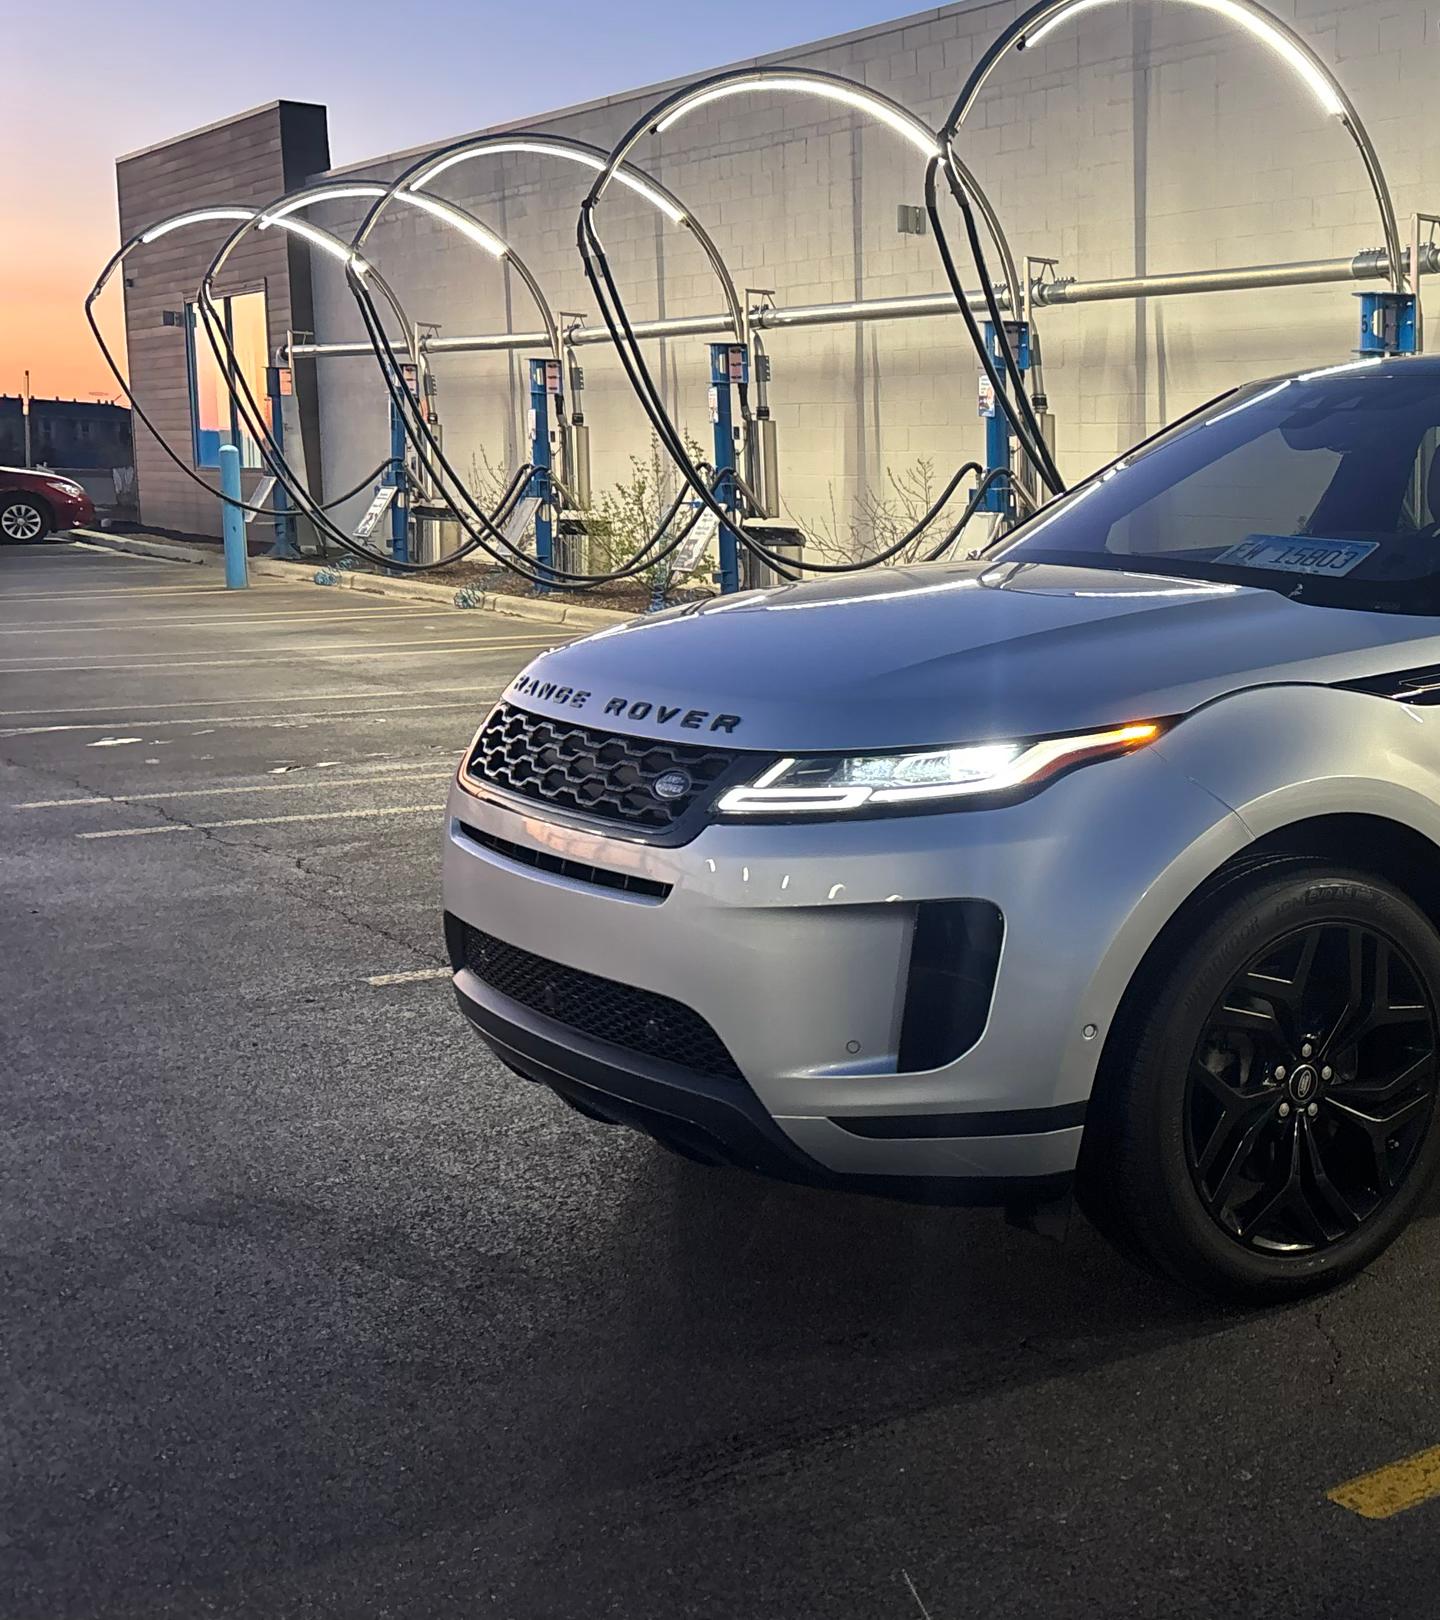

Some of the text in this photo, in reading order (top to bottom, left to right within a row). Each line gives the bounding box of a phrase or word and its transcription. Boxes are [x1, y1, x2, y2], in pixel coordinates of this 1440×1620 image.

[1361, 314, 1369, 334] 5
[1269, 545, 1359, 569] 15803
[514, 674, 743, 734] RANGE ROVER
